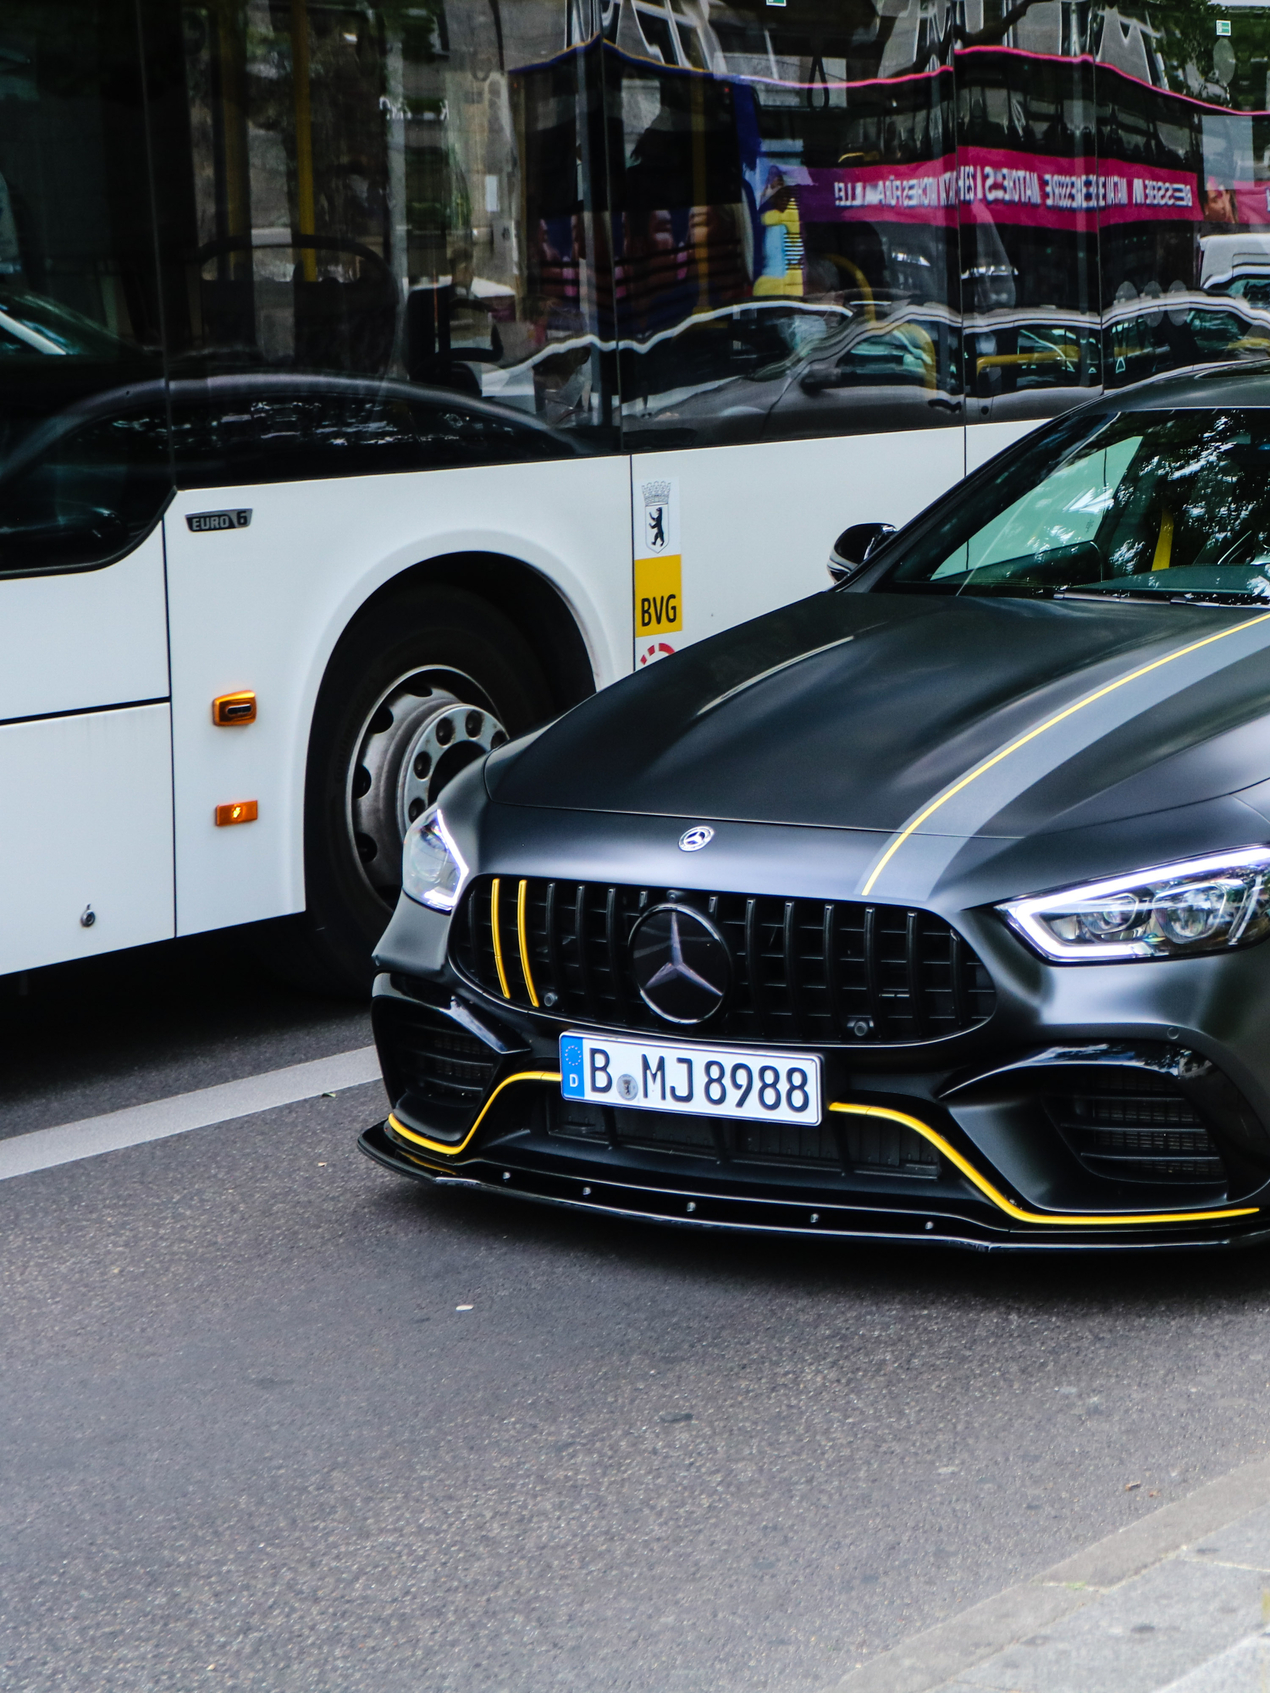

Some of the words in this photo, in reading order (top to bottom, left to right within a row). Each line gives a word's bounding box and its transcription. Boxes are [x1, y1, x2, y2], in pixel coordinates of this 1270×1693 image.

[192, 515, 230, 531] EURO
[236, 511, 248, 526] 6
[641, 593, 677, 628] BVG
[569, 1073, 579, 1088] D
[589, 1047, 613, 1094] B
